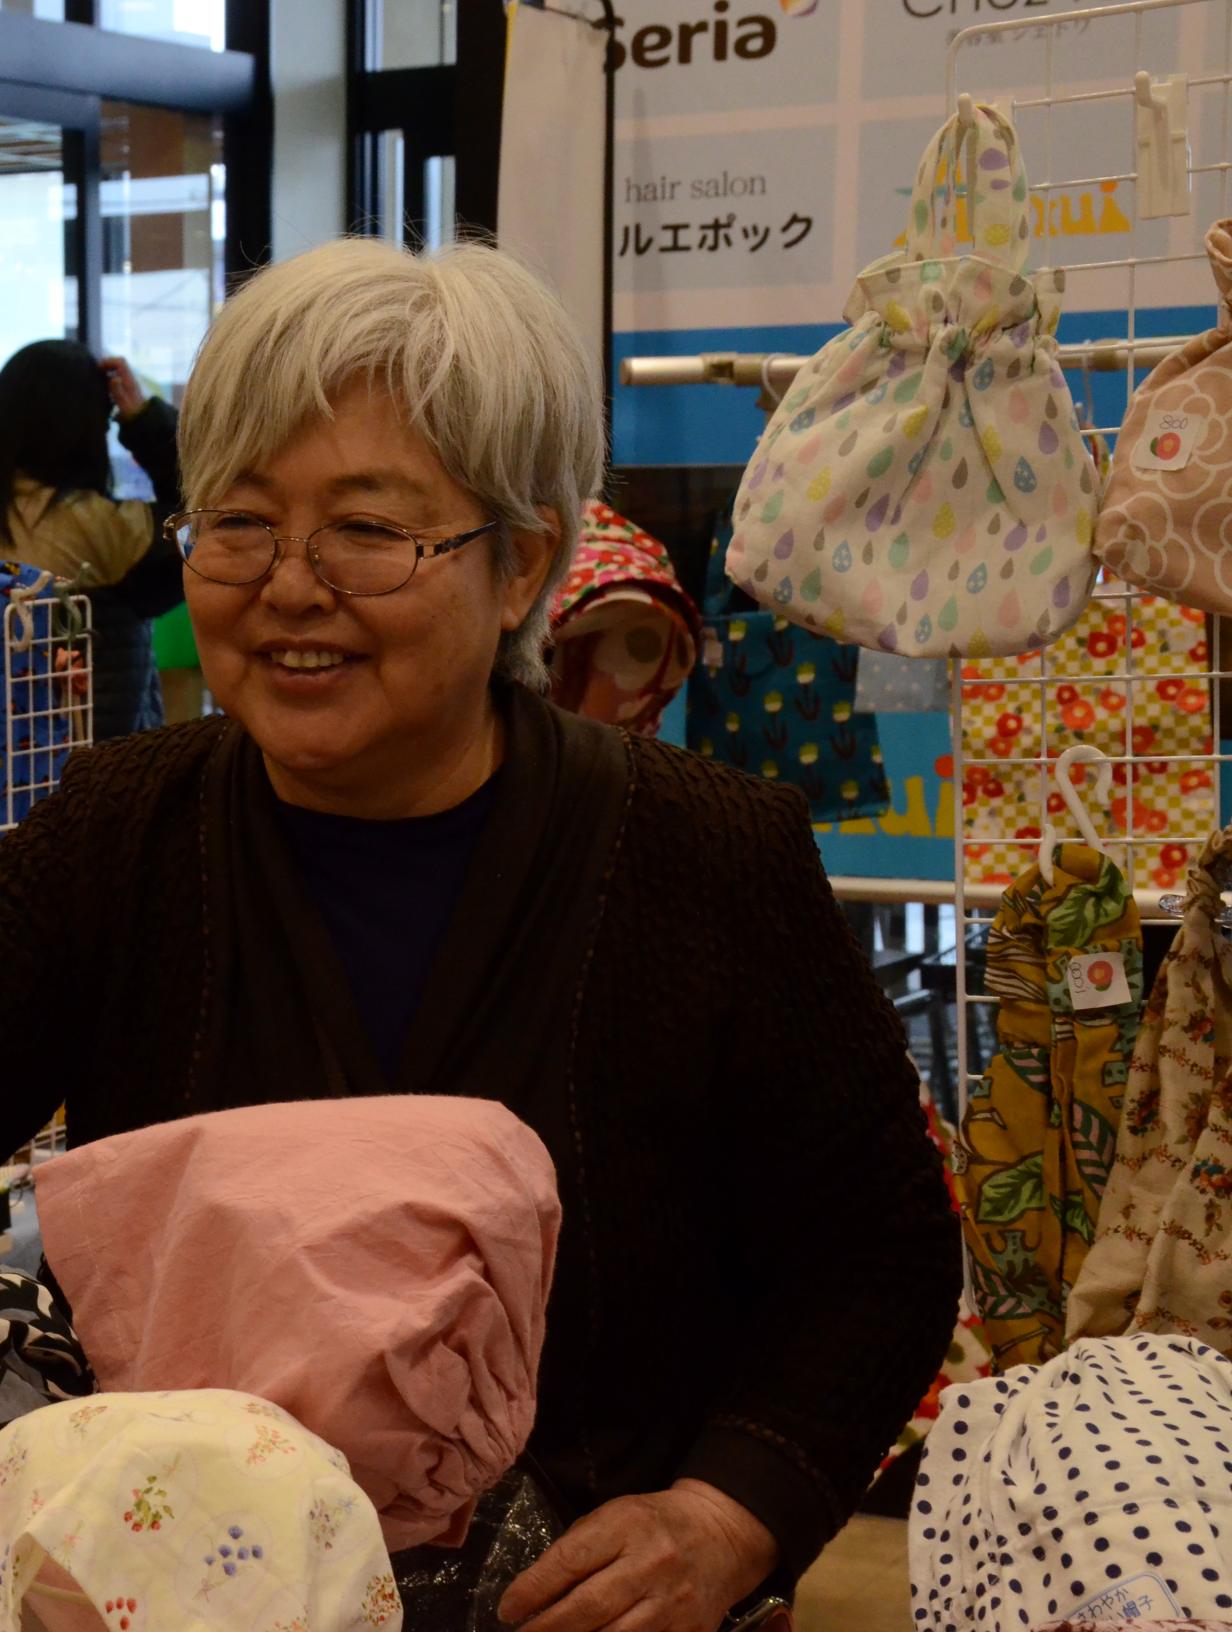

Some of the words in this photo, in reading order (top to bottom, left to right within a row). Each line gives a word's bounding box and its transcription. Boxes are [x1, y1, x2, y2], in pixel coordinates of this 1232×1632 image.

[625, 176, 681, 203] hair
[690, 170, 767, 199] salon
[619, 211, 814, 258] ルエポック
[1159, 414, 1189, 430] 800
